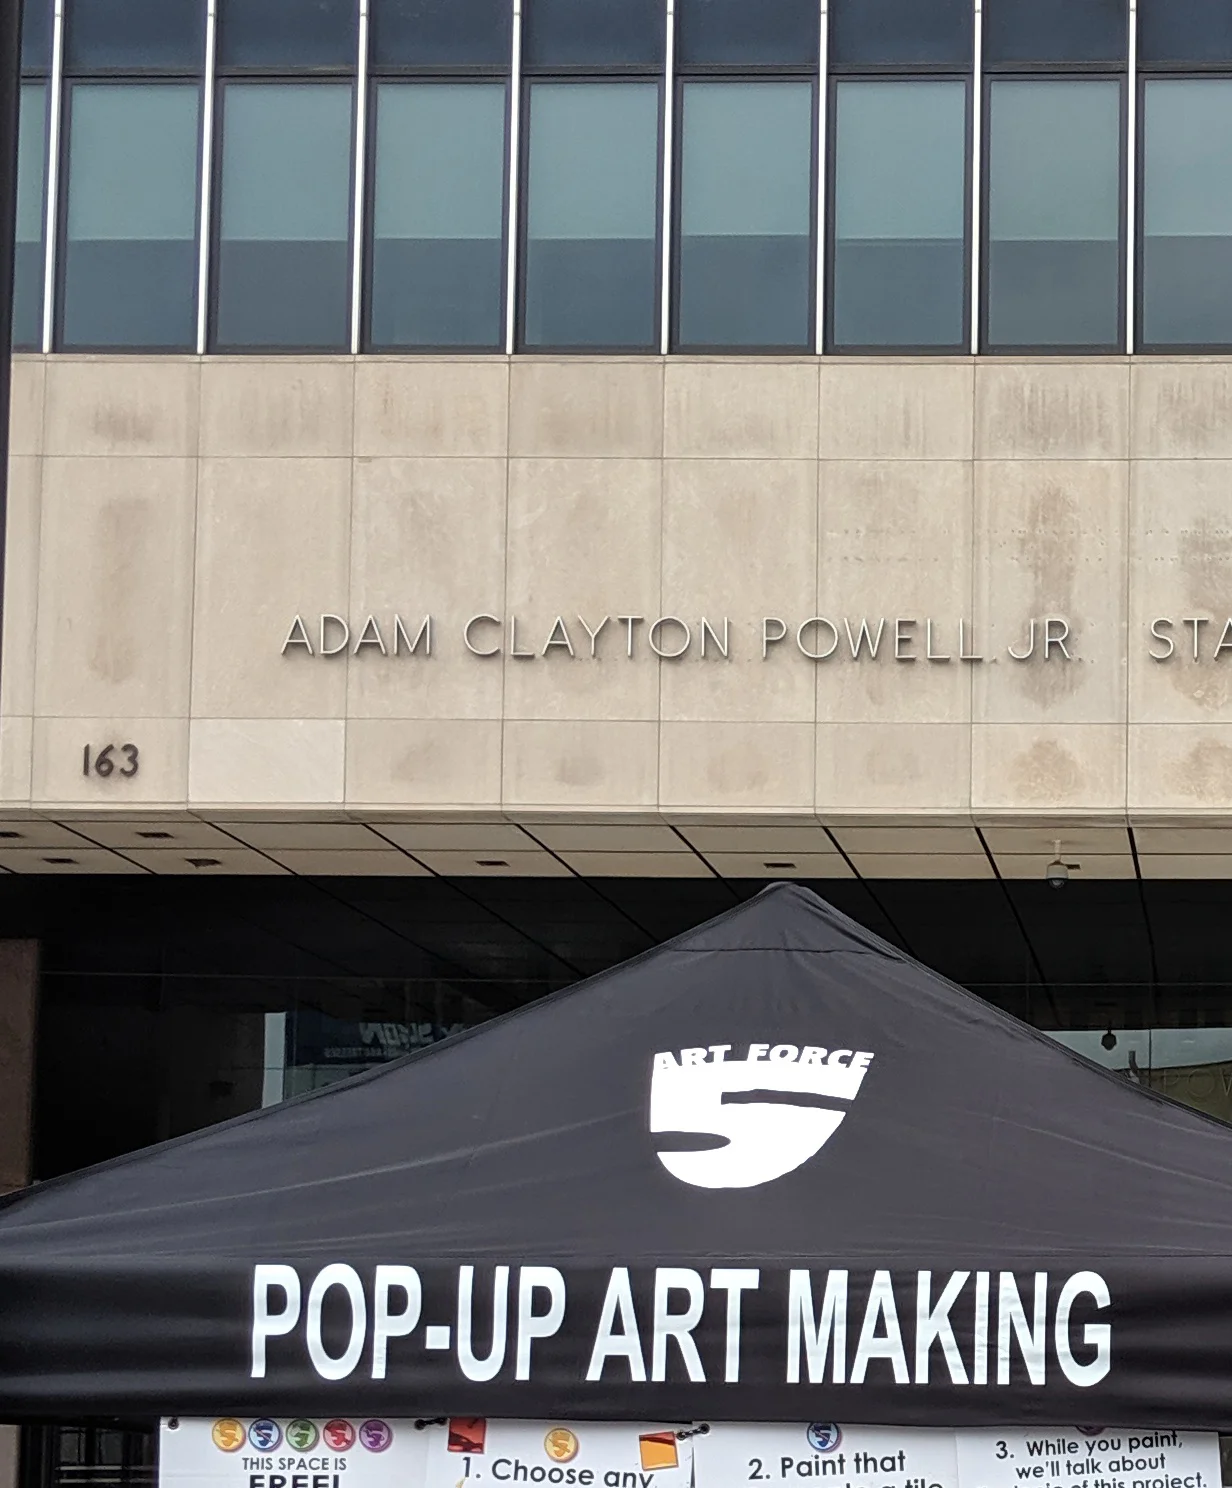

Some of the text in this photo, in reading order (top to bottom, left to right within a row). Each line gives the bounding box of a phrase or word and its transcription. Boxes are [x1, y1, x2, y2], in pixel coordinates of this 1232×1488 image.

[281, 614, 433, 657] ADAM
[464, 614, 730, 660] CLAYTON
[82, 743, 140, 777] 163
[653, 1044, 875, 1069] ART FORCE
[250, 1263, 1113, 1387] POP-UP ART MAKING
[242, 1457, 347, 1471] THIS SPACE IS
[995, 1440, 1015, 1460] 3.
[1026, 1438, 1080, 1457] While
[1086, 1439, 1121, 1457] you
[462, 1456, 481, 1479] 1.
[491, 1458, 595, 1486] Choose
[748, 1450, 906, 1480] 2. Paint that
[1015, 1453, 1166, 1479] we'll talk about
